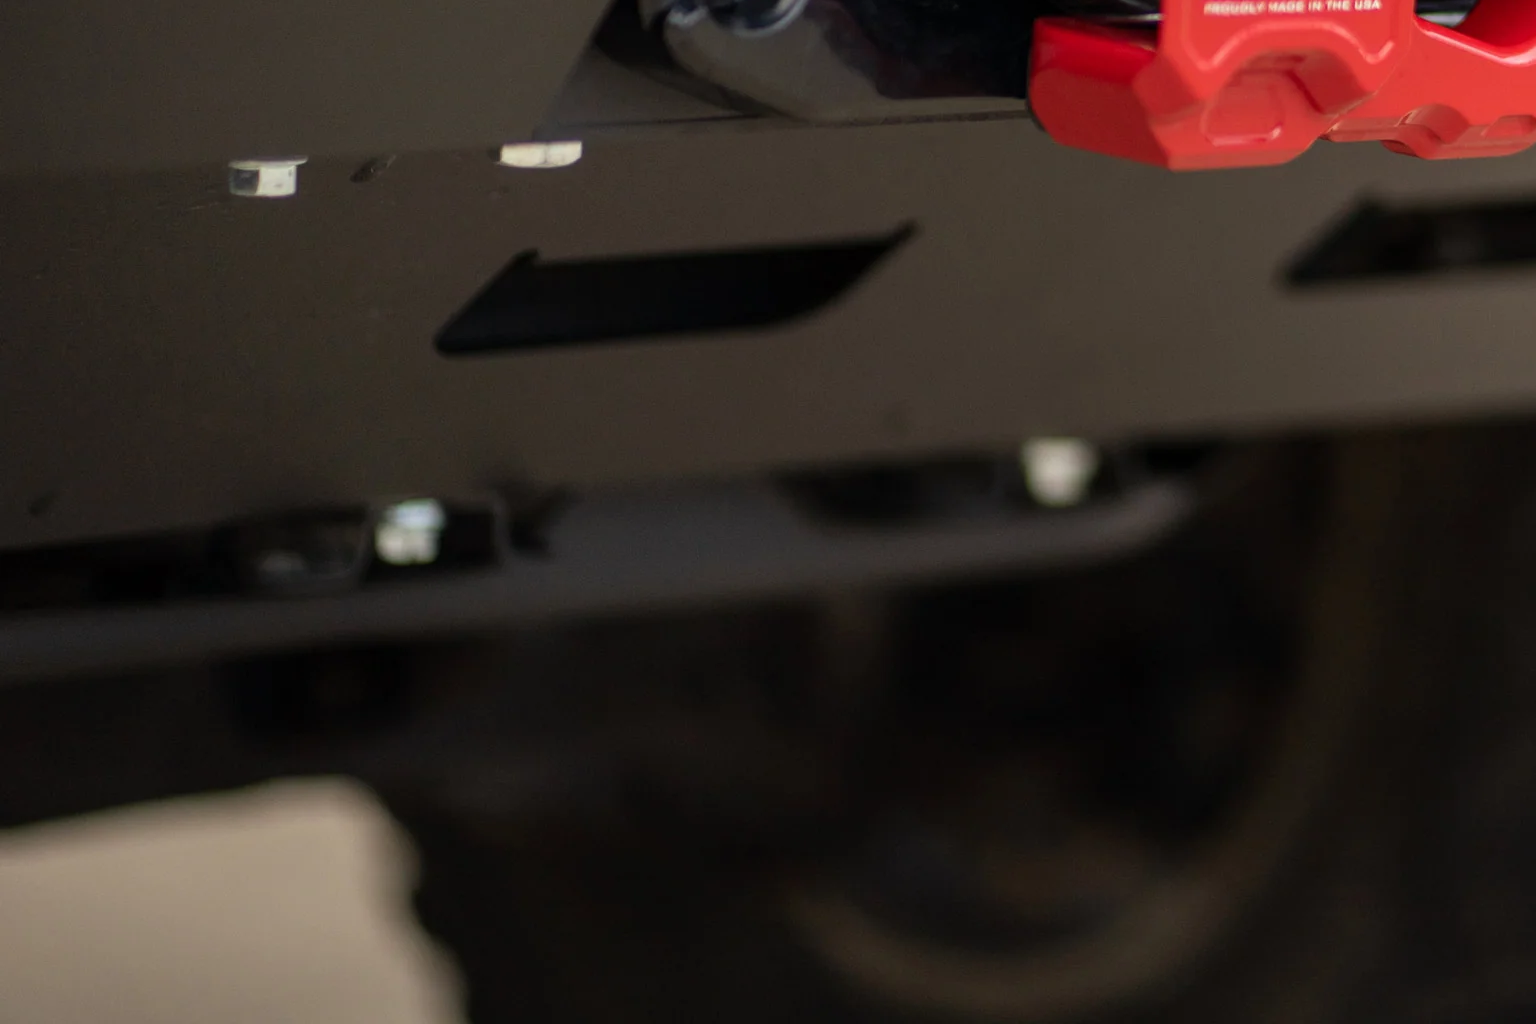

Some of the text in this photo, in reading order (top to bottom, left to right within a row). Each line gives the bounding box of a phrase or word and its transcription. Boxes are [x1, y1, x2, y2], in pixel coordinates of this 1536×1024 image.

[1203, 0, 1264, 16] PROUDLY
[1267, 0, 1305, 14] MADE
[1308, 0, 1321, 12] IN
